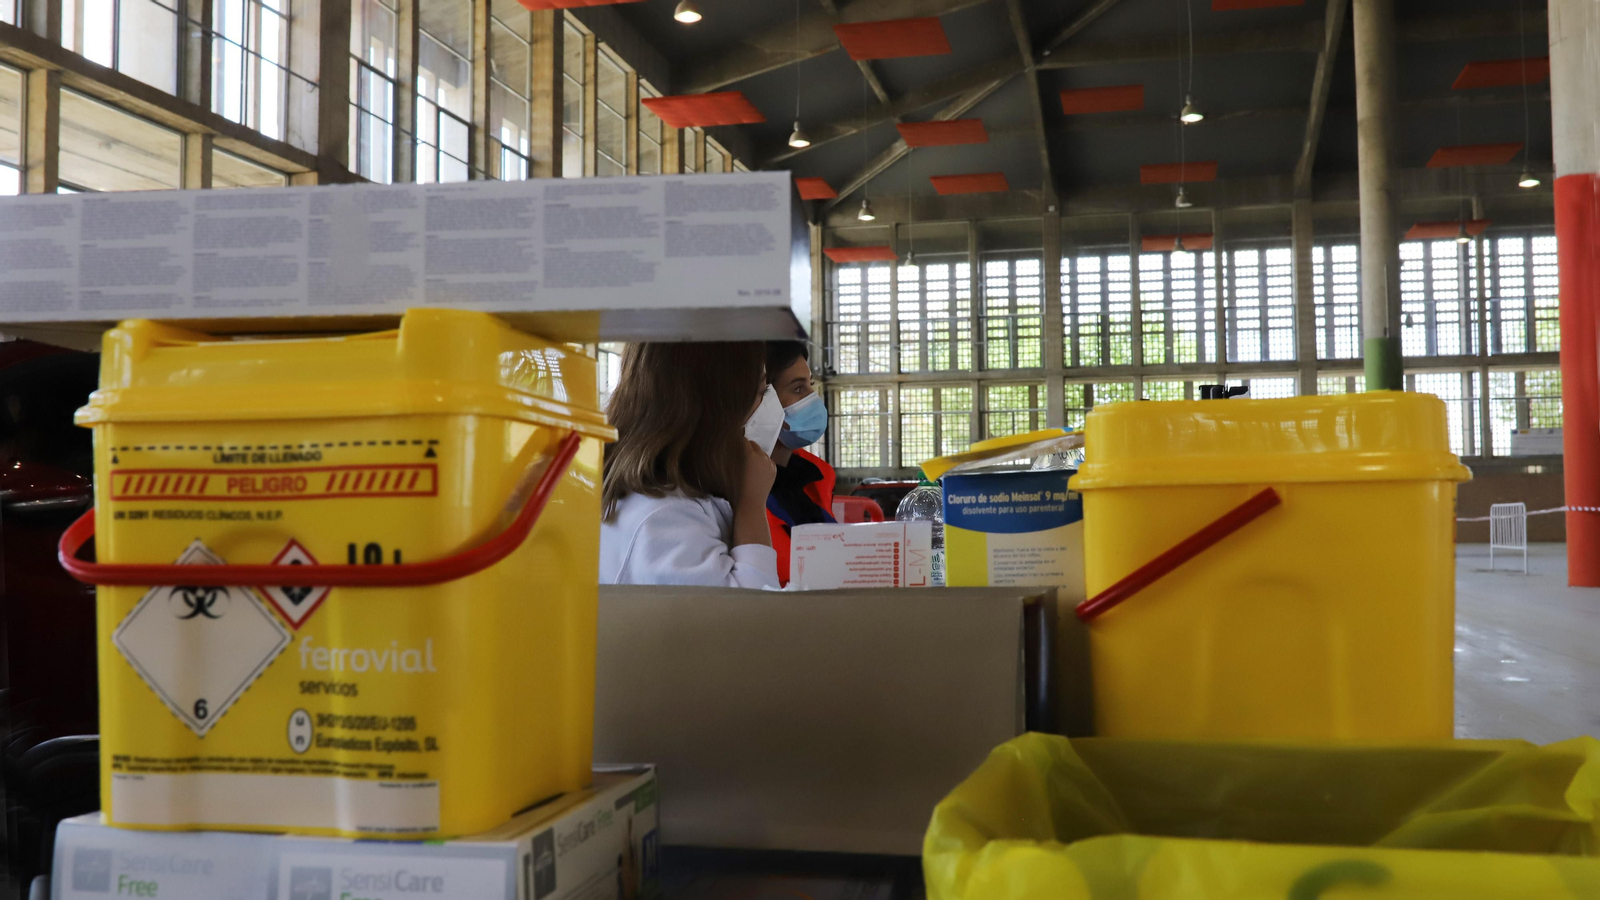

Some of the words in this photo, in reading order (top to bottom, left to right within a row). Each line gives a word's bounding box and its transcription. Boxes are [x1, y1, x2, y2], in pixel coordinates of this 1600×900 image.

[226, 475, 307, 494] PELIGRO
[948, 494, 976, 505] Cloruro
[978, 493, 987, 503] de
[989, 492, 1009, 503] sodio
[1045, 492, 1051, 501] 9
[152, 510, 204, 520] RESIDUOS
[962, 505, 997, 515] disolvente
[998, 506, 1014, 516] para
[1015, 505, 1027, 514] uso
[1029, 503, 1065, 514] parenteral
[298, 635, 437, 674] ferrovial
[298, 679, 359, 697] servicios
[193, 698, 208, 720] 6
[118, 874, 159, 897] Free
[339, 867, 444, 893] SensiCare
